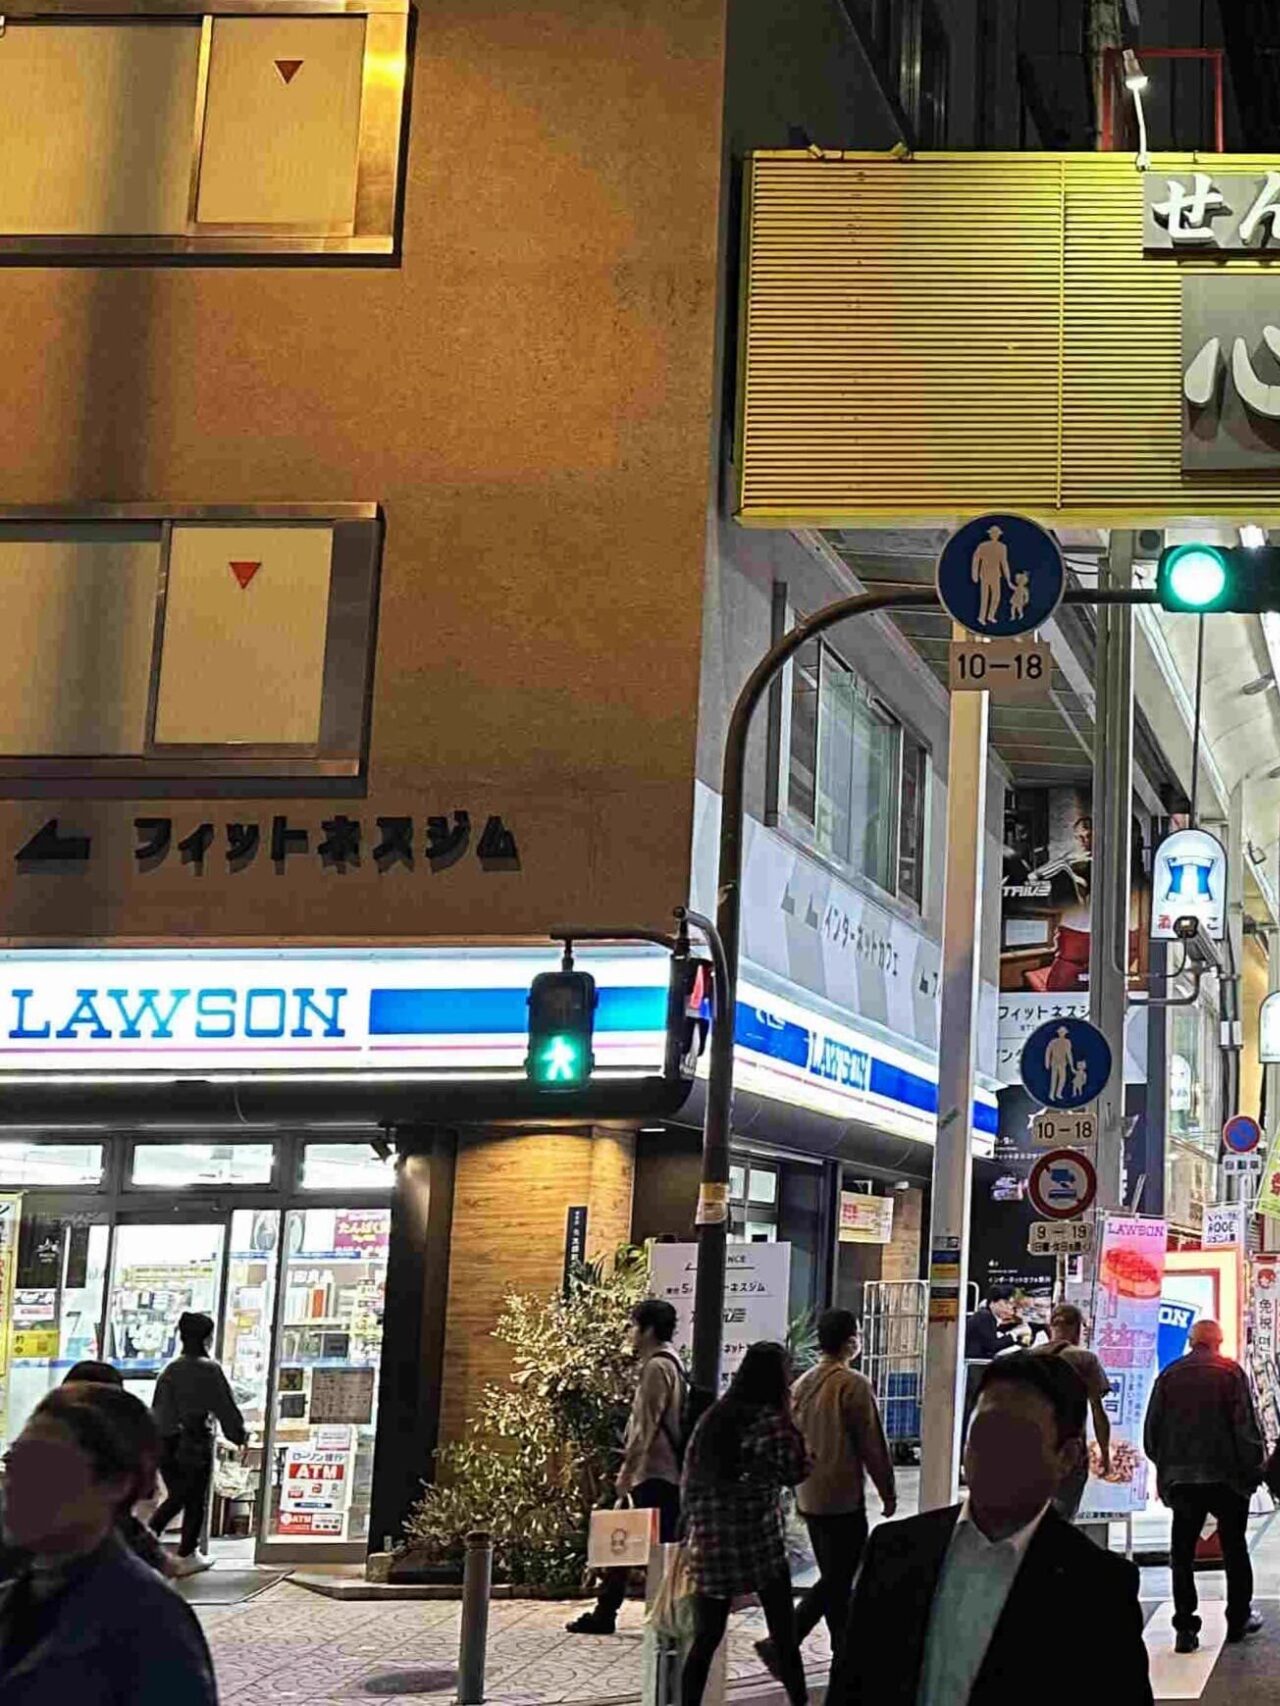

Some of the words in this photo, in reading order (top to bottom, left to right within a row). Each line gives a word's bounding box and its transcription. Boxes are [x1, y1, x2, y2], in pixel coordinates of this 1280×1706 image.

[134, 810, 519, 870] フィットネスジム
[9, 987, 349, 1039] LAWSON
[809, 1021, 869, 1092] LAWSON
[1107, 1221, 1164, 1237] LAWSON
[296, 1464, 338, 1479] ATM
